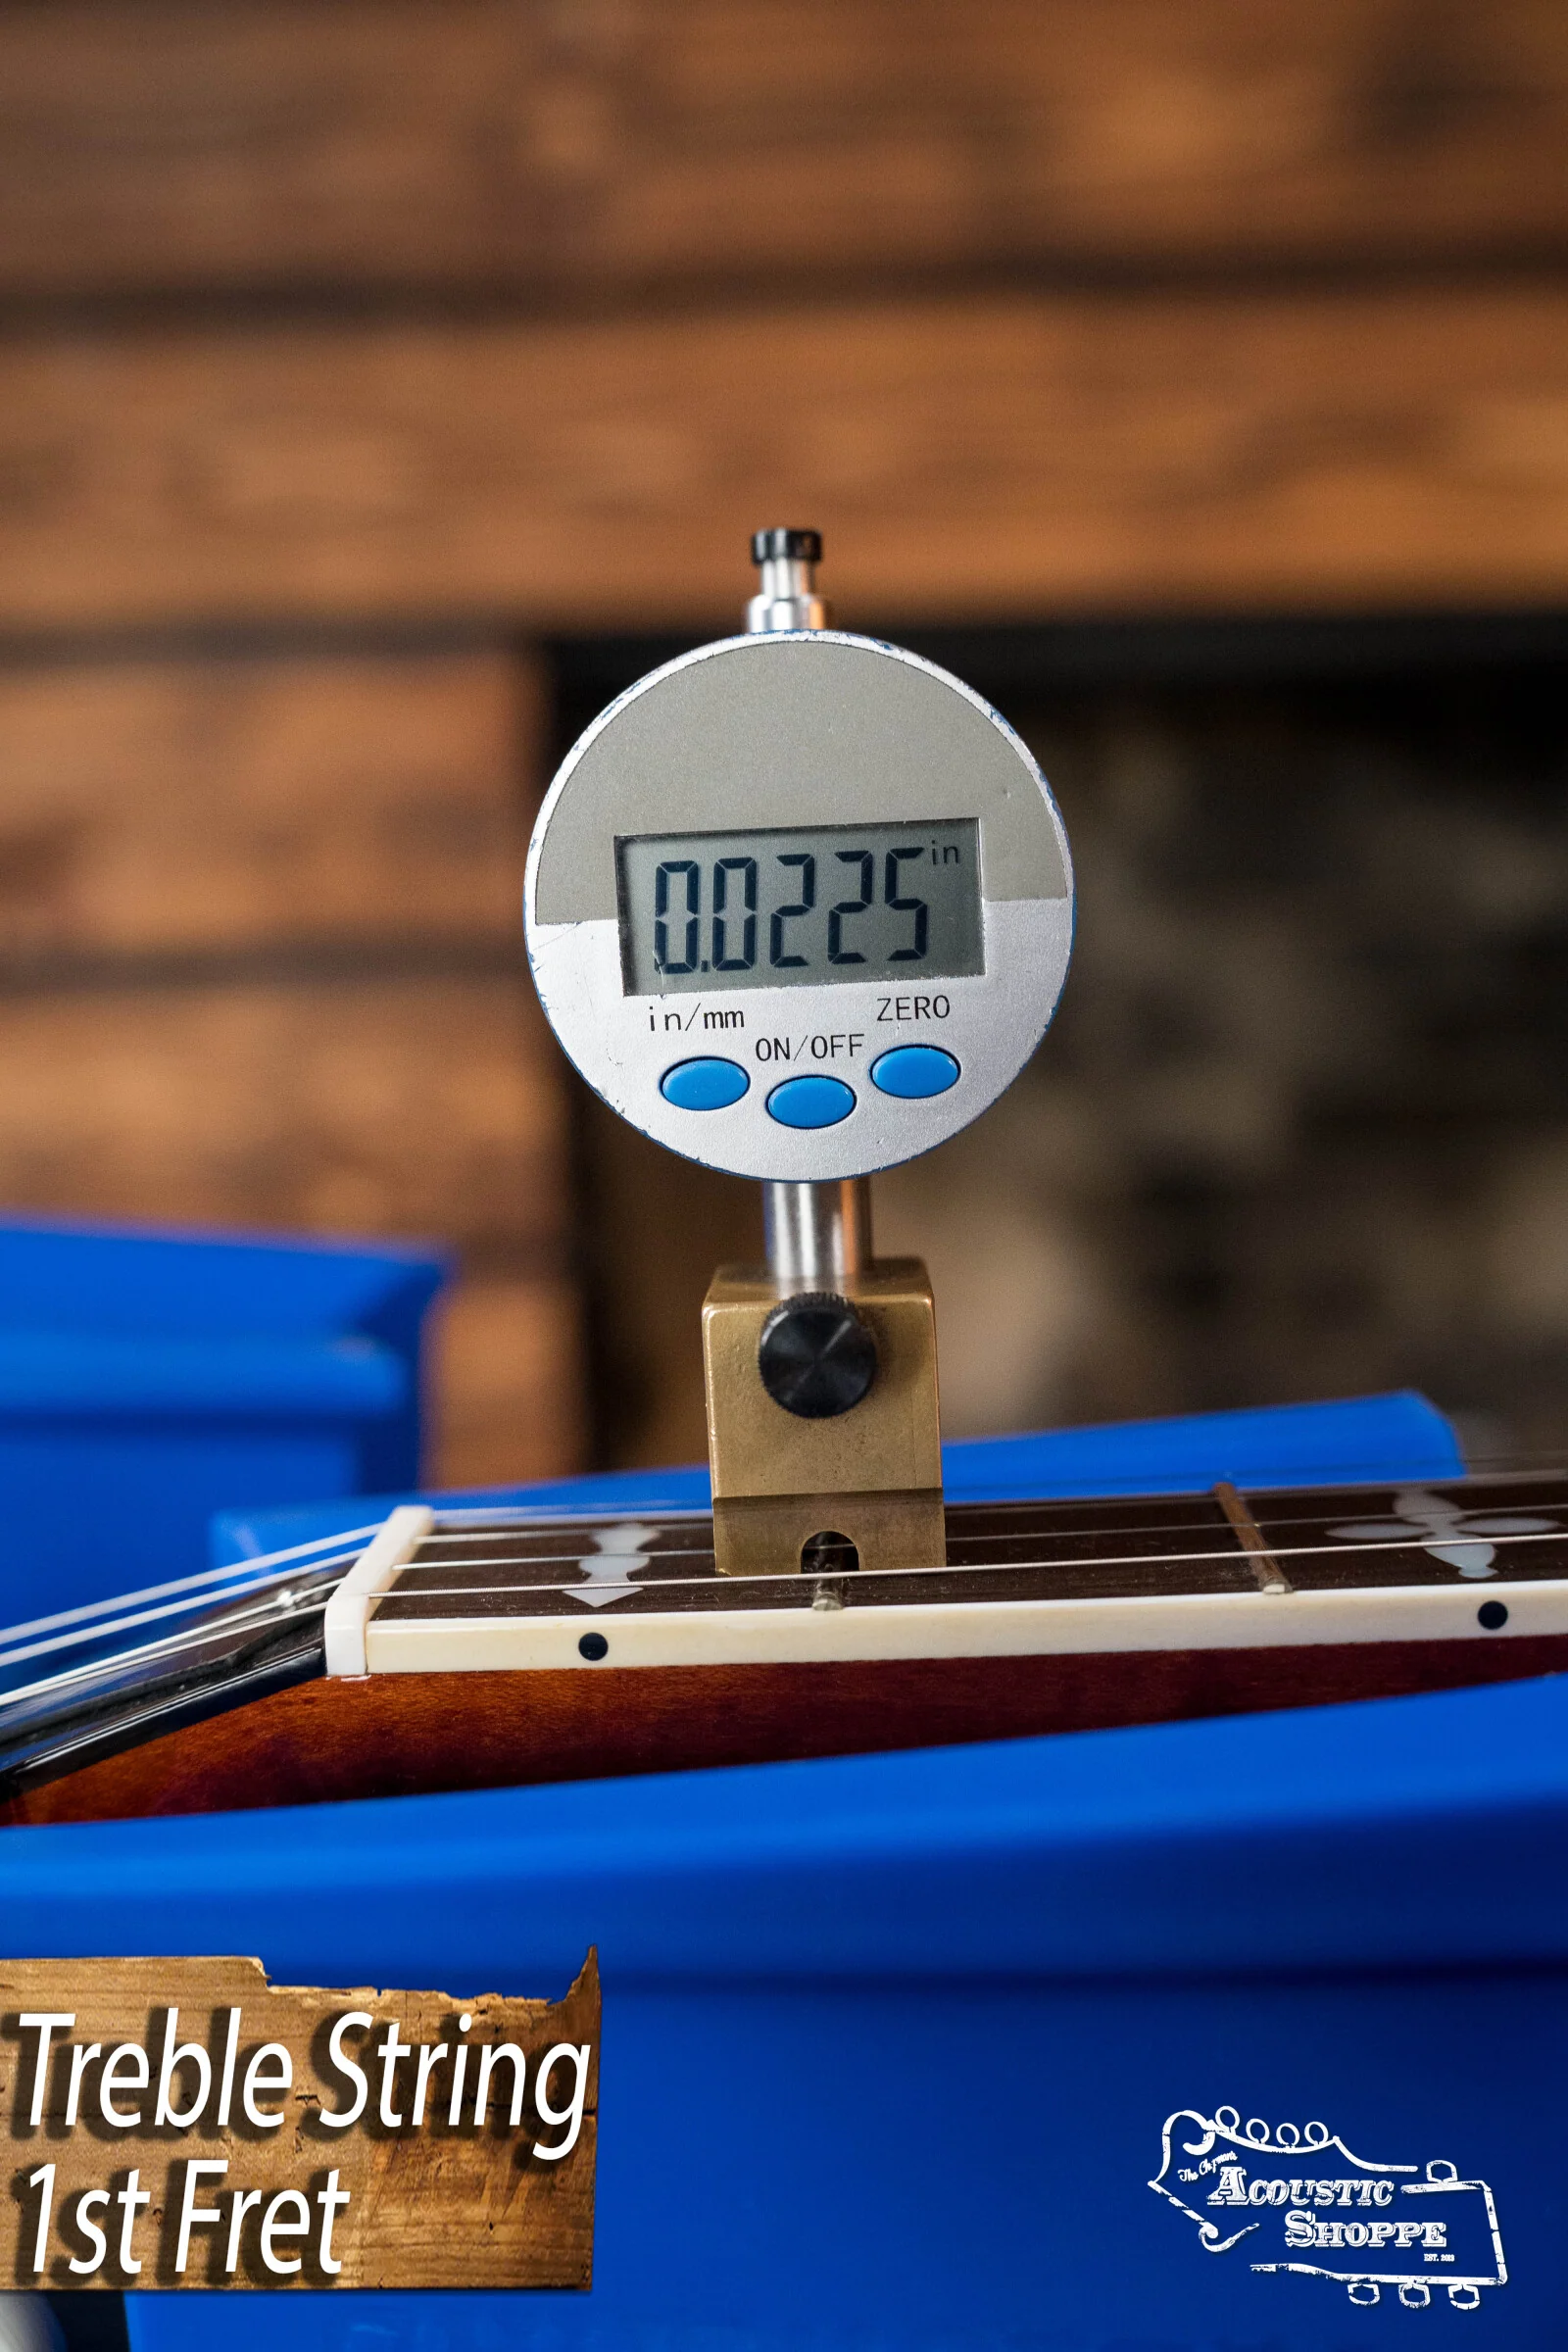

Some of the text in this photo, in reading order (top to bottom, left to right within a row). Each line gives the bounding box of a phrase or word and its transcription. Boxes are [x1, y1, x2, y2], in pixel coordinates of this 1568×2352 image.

[654, 840, 960, 975] 0.0225 in
[649, 1003, 746, 1032] in/mm
[877, 995, 951, 1022] ZERO
[756, 1033, 865, 1062] ON/OFF
